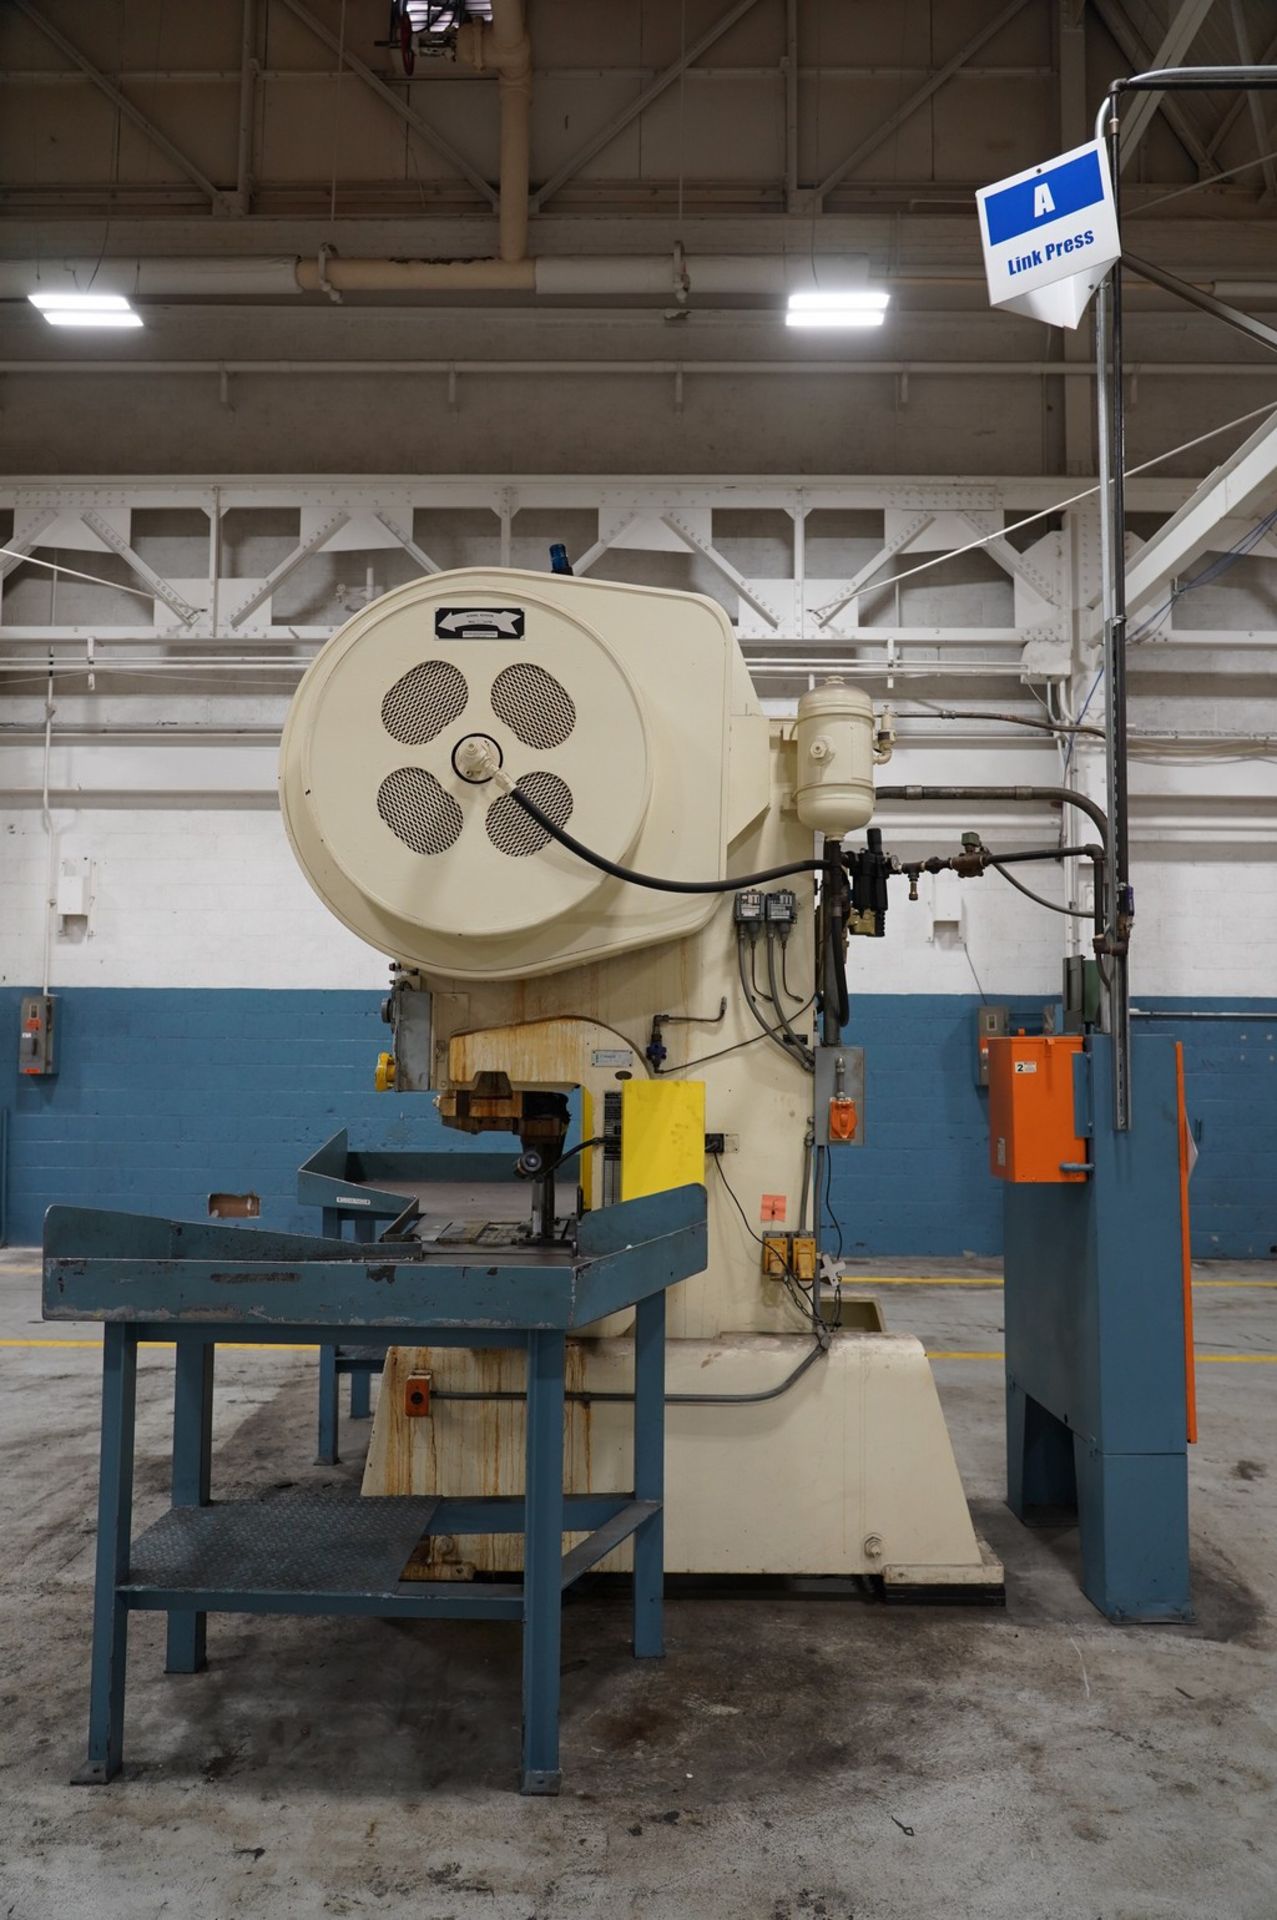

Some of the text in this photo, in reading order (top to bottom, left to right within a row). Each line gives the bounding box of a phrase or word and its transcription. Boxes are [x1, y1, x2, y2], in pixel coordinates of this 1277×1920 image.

[1034, 182, 1056, 218] A
[1007, 230, 1095, 276] Link Press
[1017, 1063, 1024, 1072] 2
